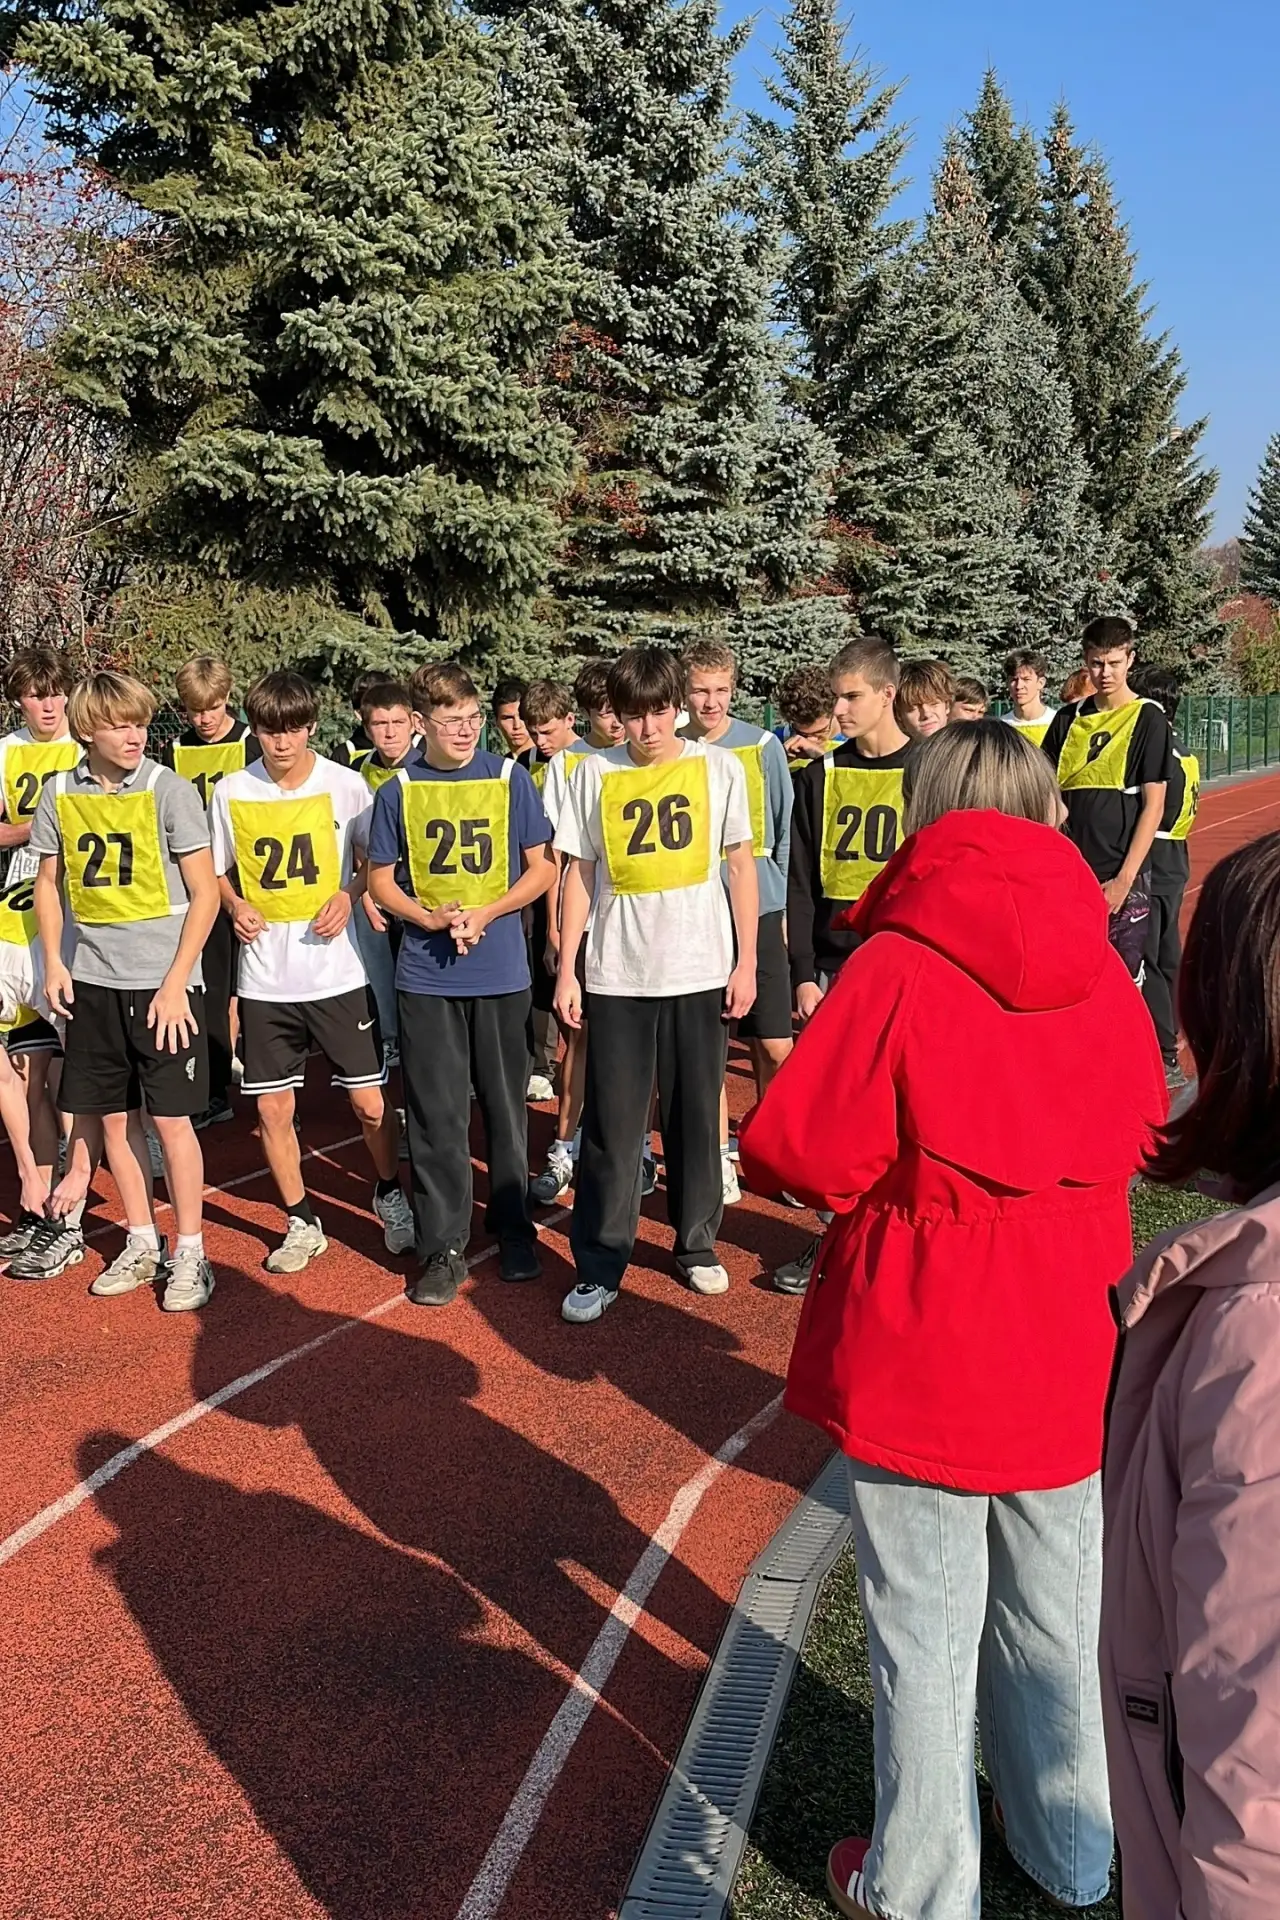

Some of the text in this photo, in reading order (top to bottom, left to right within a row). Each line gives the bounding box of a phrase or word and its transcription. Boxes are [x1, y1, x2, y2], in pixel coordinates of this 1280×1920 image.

[16, 771, 58, 815] 2
[426, 819, 493, 874] 25
[623, 794, 693, 856] 26
[835, 805, 897, 862] 20
[78, 832, 133, 887] 27
[254, 833, 320, 890] 24
